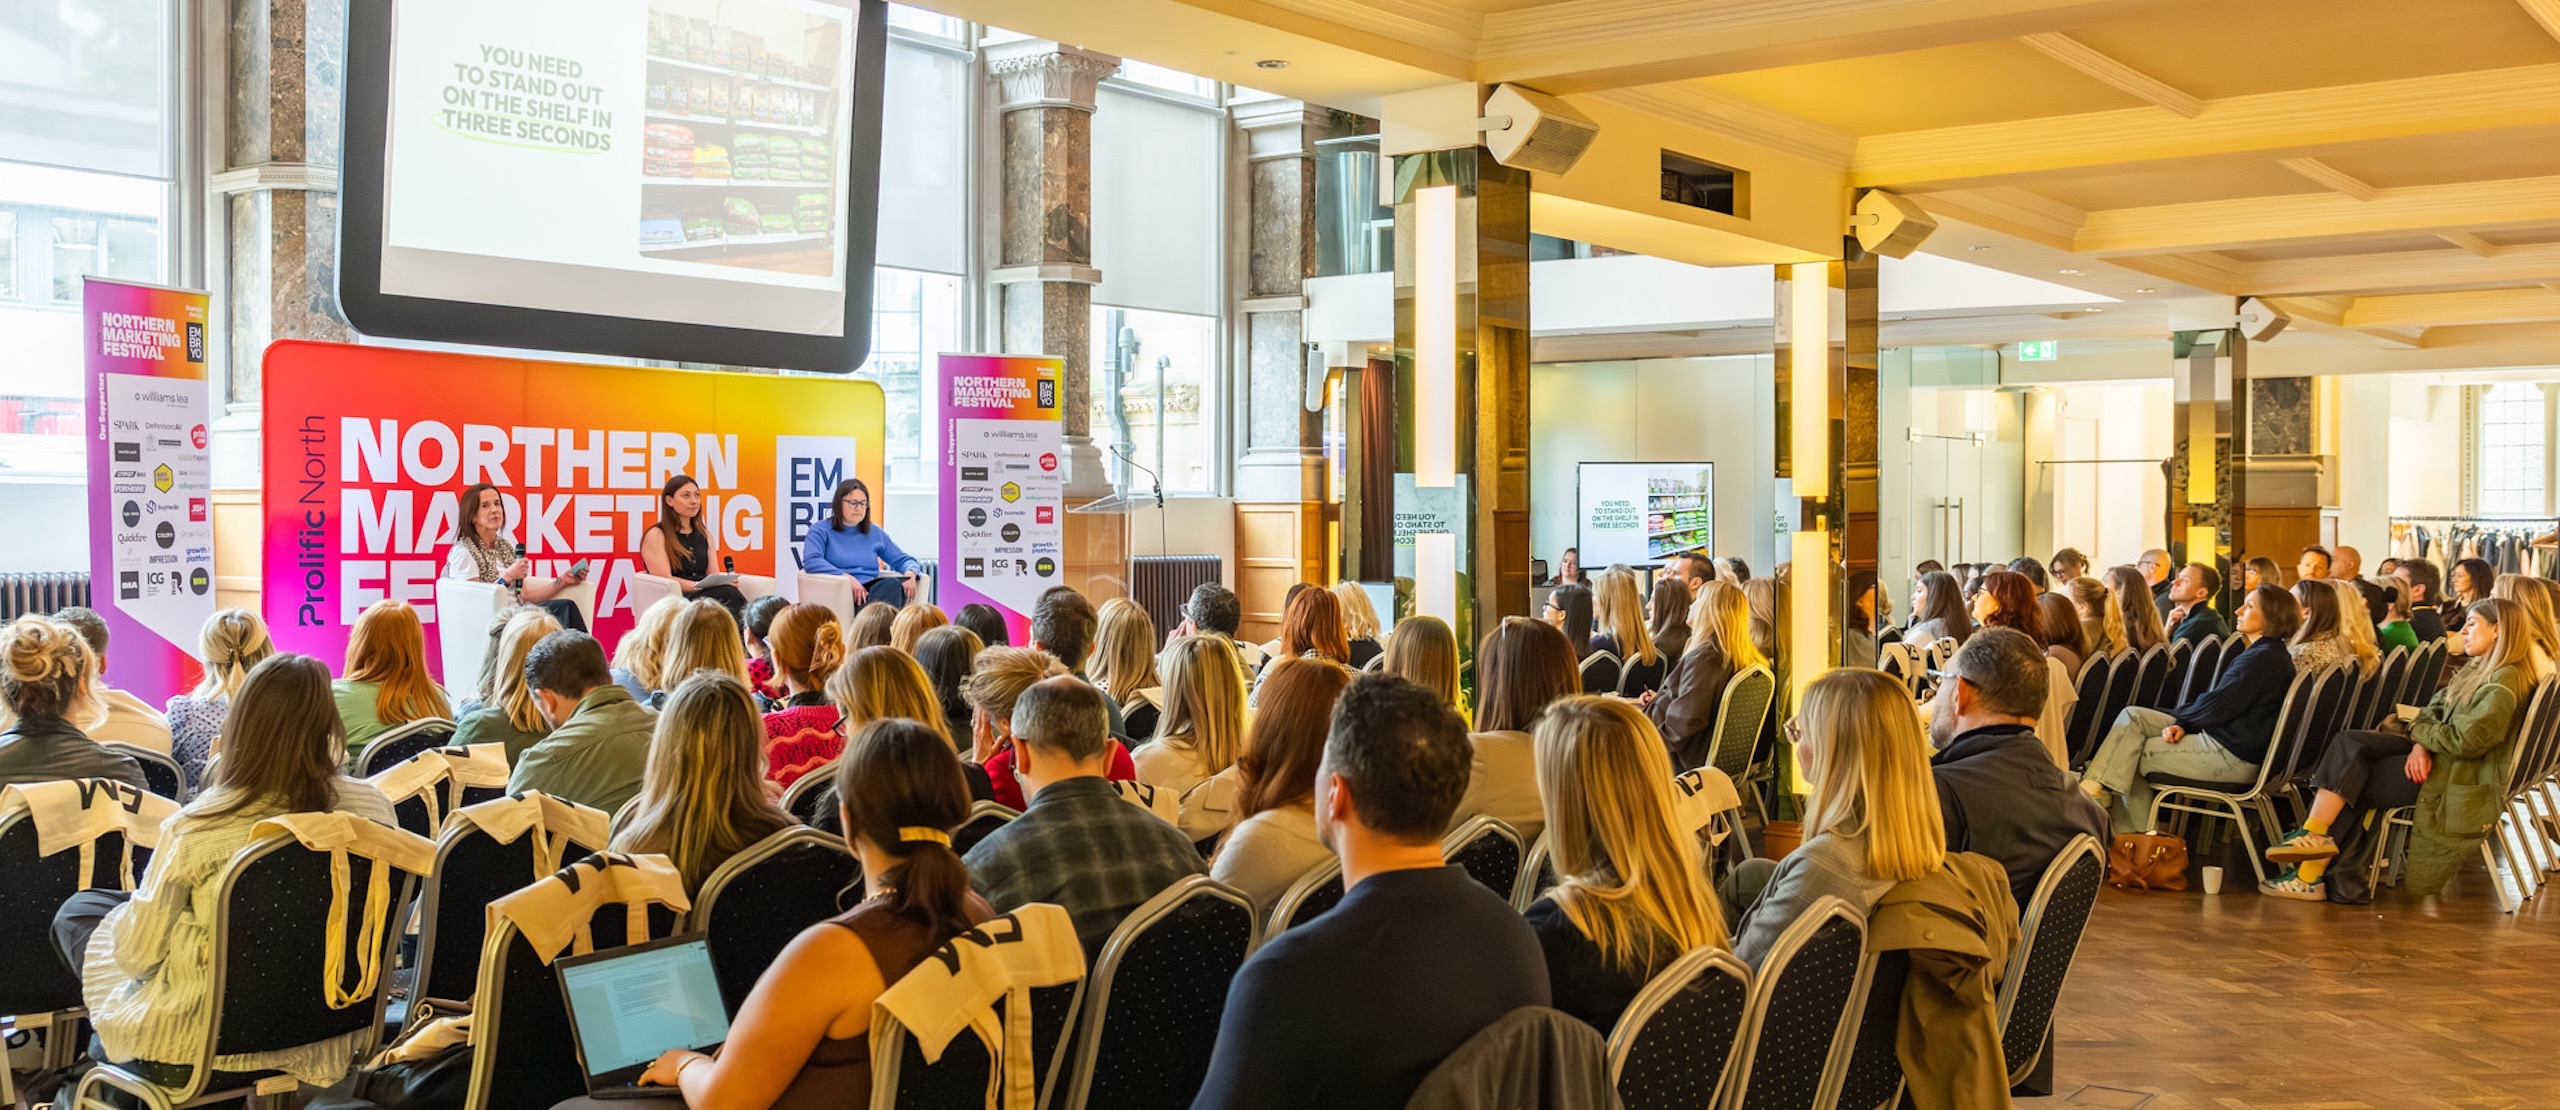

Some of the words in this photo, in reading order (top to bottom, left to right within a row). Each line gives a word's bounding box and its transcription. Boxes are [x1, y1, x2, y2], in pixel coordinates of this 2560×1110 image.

[480, 44, 524, 68] YOU
[528, 53, 582, 78] NEED
[454, 63, 484, 85] TO
[489, 70, 558, 97] STAND
[562, 83, 604, 106] OUT
[443, 85, 475, 108] ON
[481, 92, 522, 116] THE
[526, 100, 588, 125] SHELF
[592, 110, 612, 130] IN
[442, 108, 511, 136] THREE
[516, 120, 611, 152] SECONDS
[102, 312, 175, 333] NORTHERN
[102, 327, 180, 348] MARKETING
[103, 342, 164, 360] FESTIVAL
[954, 376, 1026, 388] NORTHERN
[98, 372, 107, 422] Supporters
[142, 391, 175, 403] williams
[176, 394, 189, 404] lea
[954, 387, 1032, 398] MARKETING
[954, 397, 1015, 408] FESTIVAL
[113, 420, 140, 431] SPARK
[992, 431, 1024, 439] williams
[1026, 431, 1038, 439] lea
[299, 415, 325, 504] North
[340, 416, 738, 490] NORTHERN
[961, 451, 988, 459] SPARK
[790, 457, 842, 498] EM
[118, 532, 147, 544] Quickfire
[962, 530, 993, 538] Quickfire
[186, 547, 207, 556] growth
[149, 555, 178, 564] IMPRESSION
[186, 555, 210, 563] platform
[992, 559, 1008, 568] ICG
[299, 510, 325, 626] Prolific
[147, 572, 164, 585] ICG
